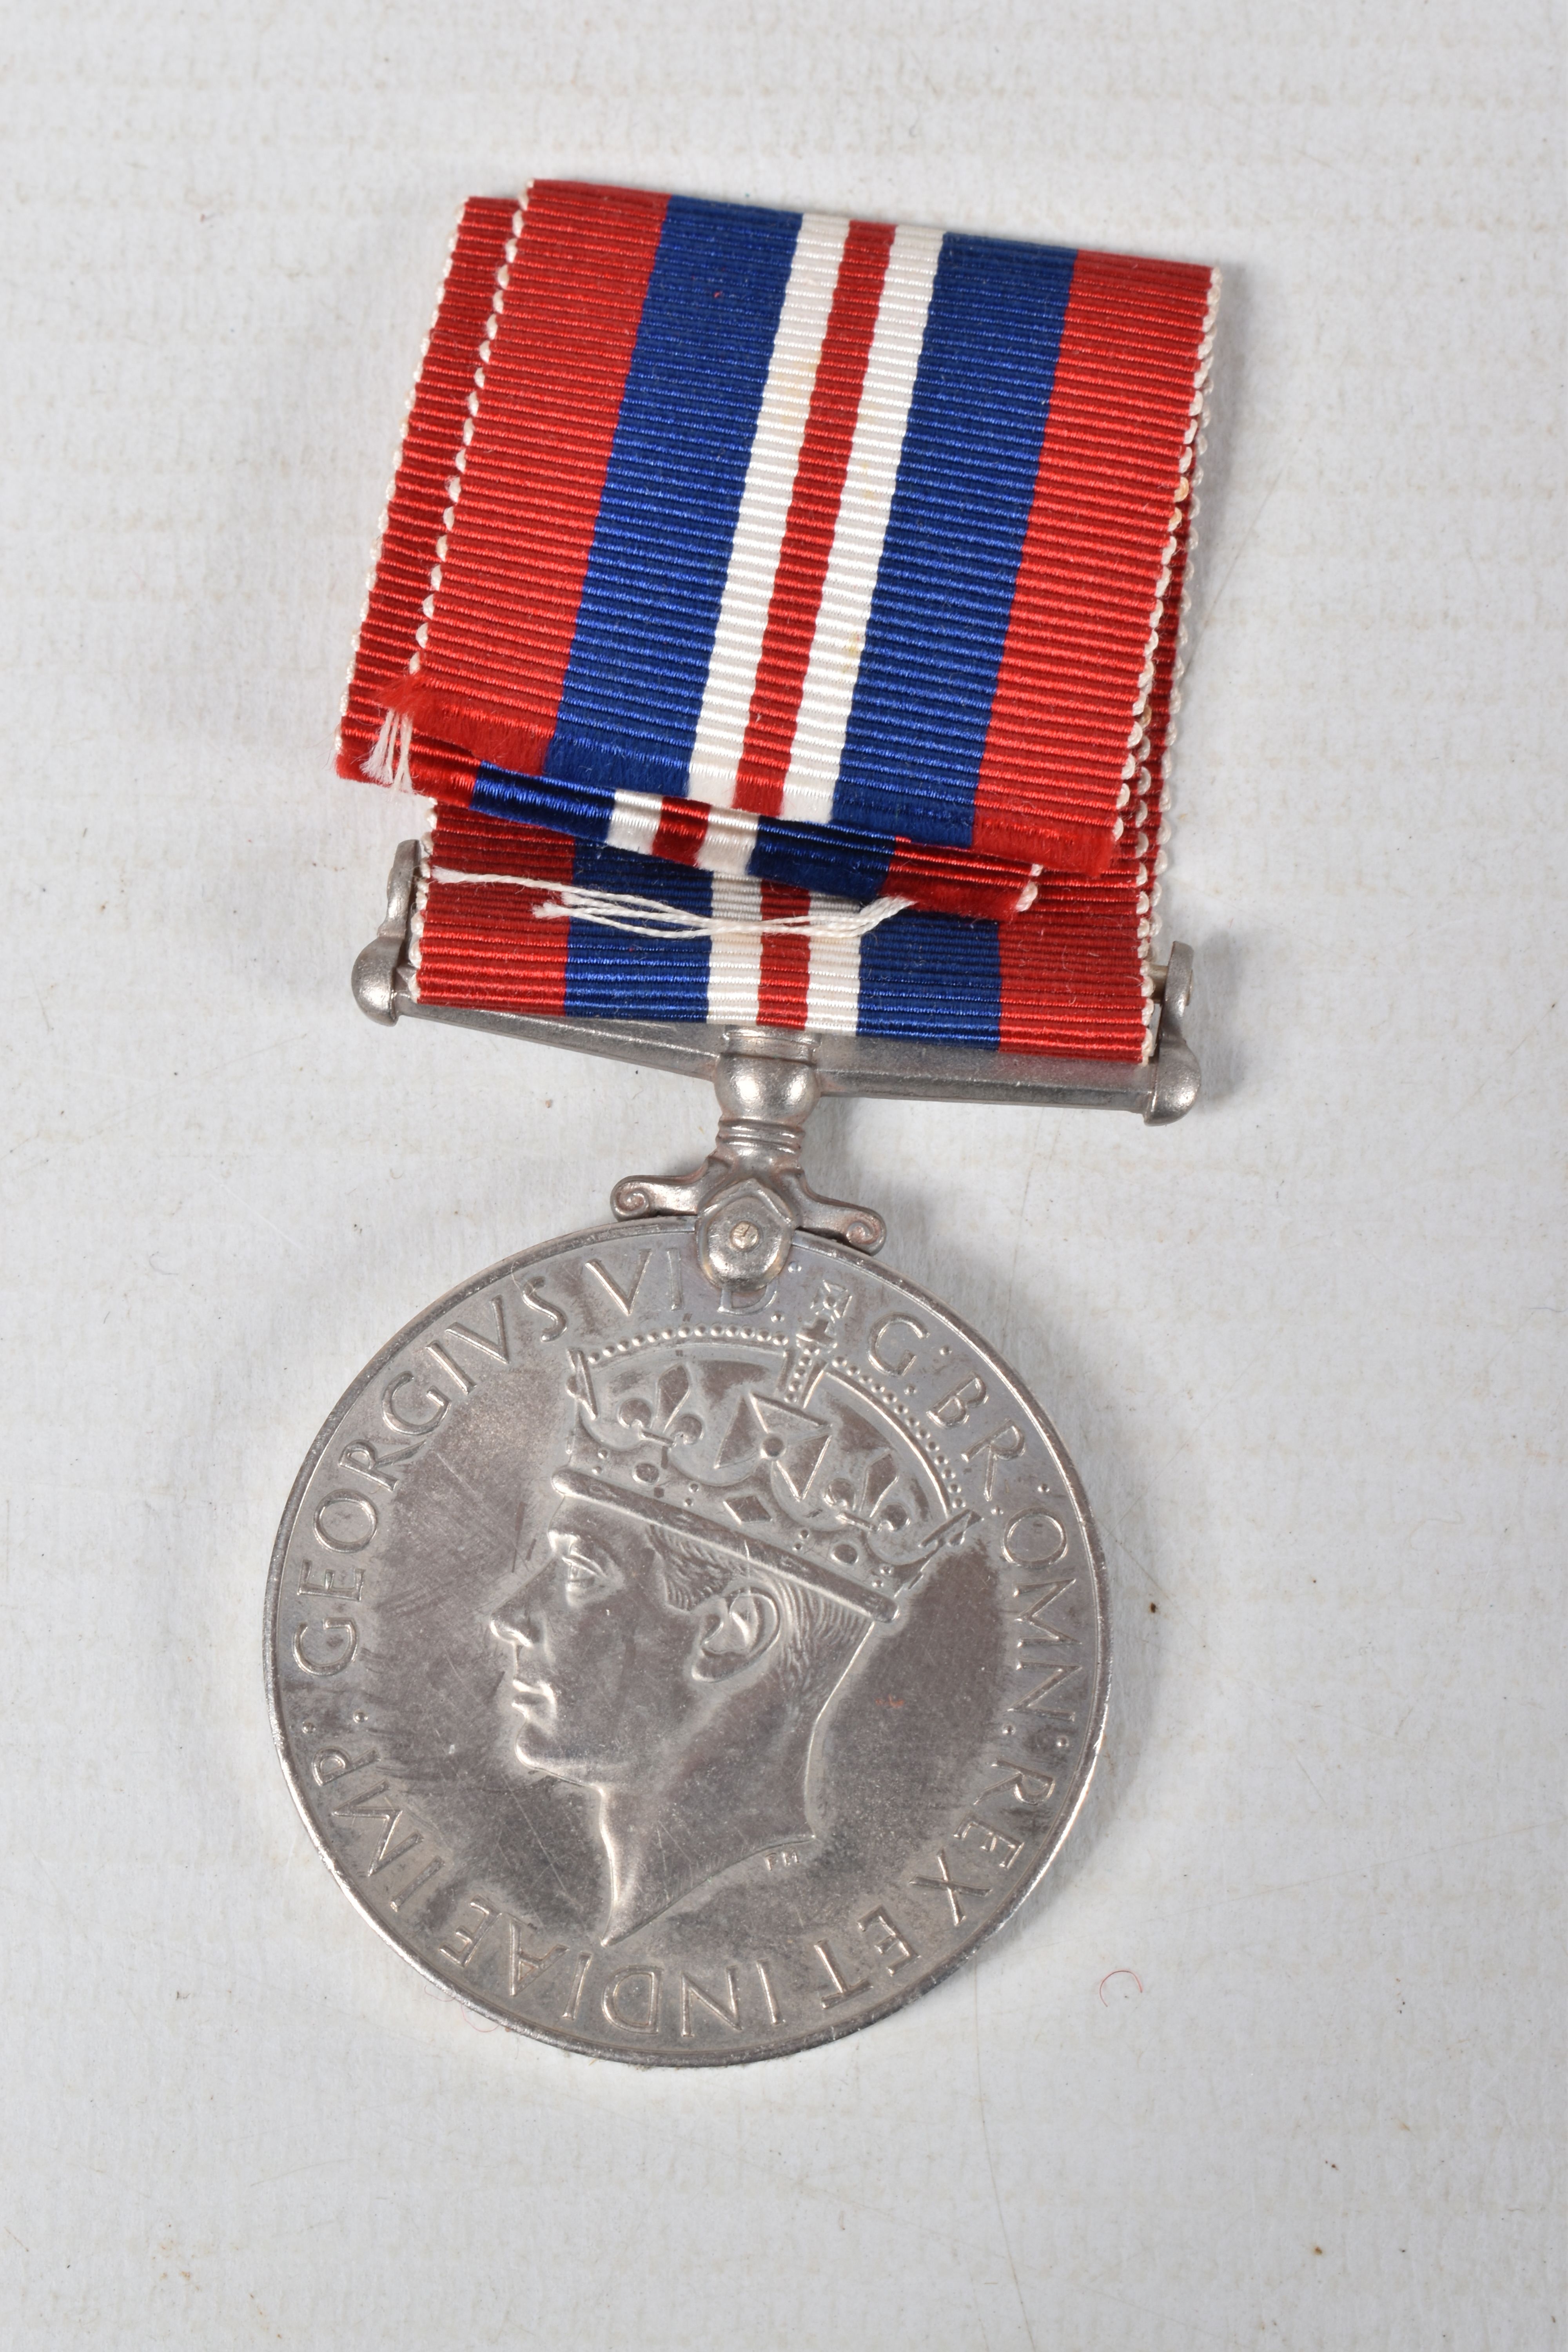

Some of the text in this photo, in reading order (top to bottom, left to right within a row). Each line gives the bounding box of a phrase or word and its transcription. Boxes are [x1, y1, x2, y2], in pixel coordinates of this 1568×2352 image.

[585, 1248, 684, 1316] VI
[292, 1276, 568, 1676] GEORGIVS
[908, 1758, 1056, 1926] REX
[439, 1894, 783, 2038] INDIAE
[813, 1904, 920, 2009] ET
